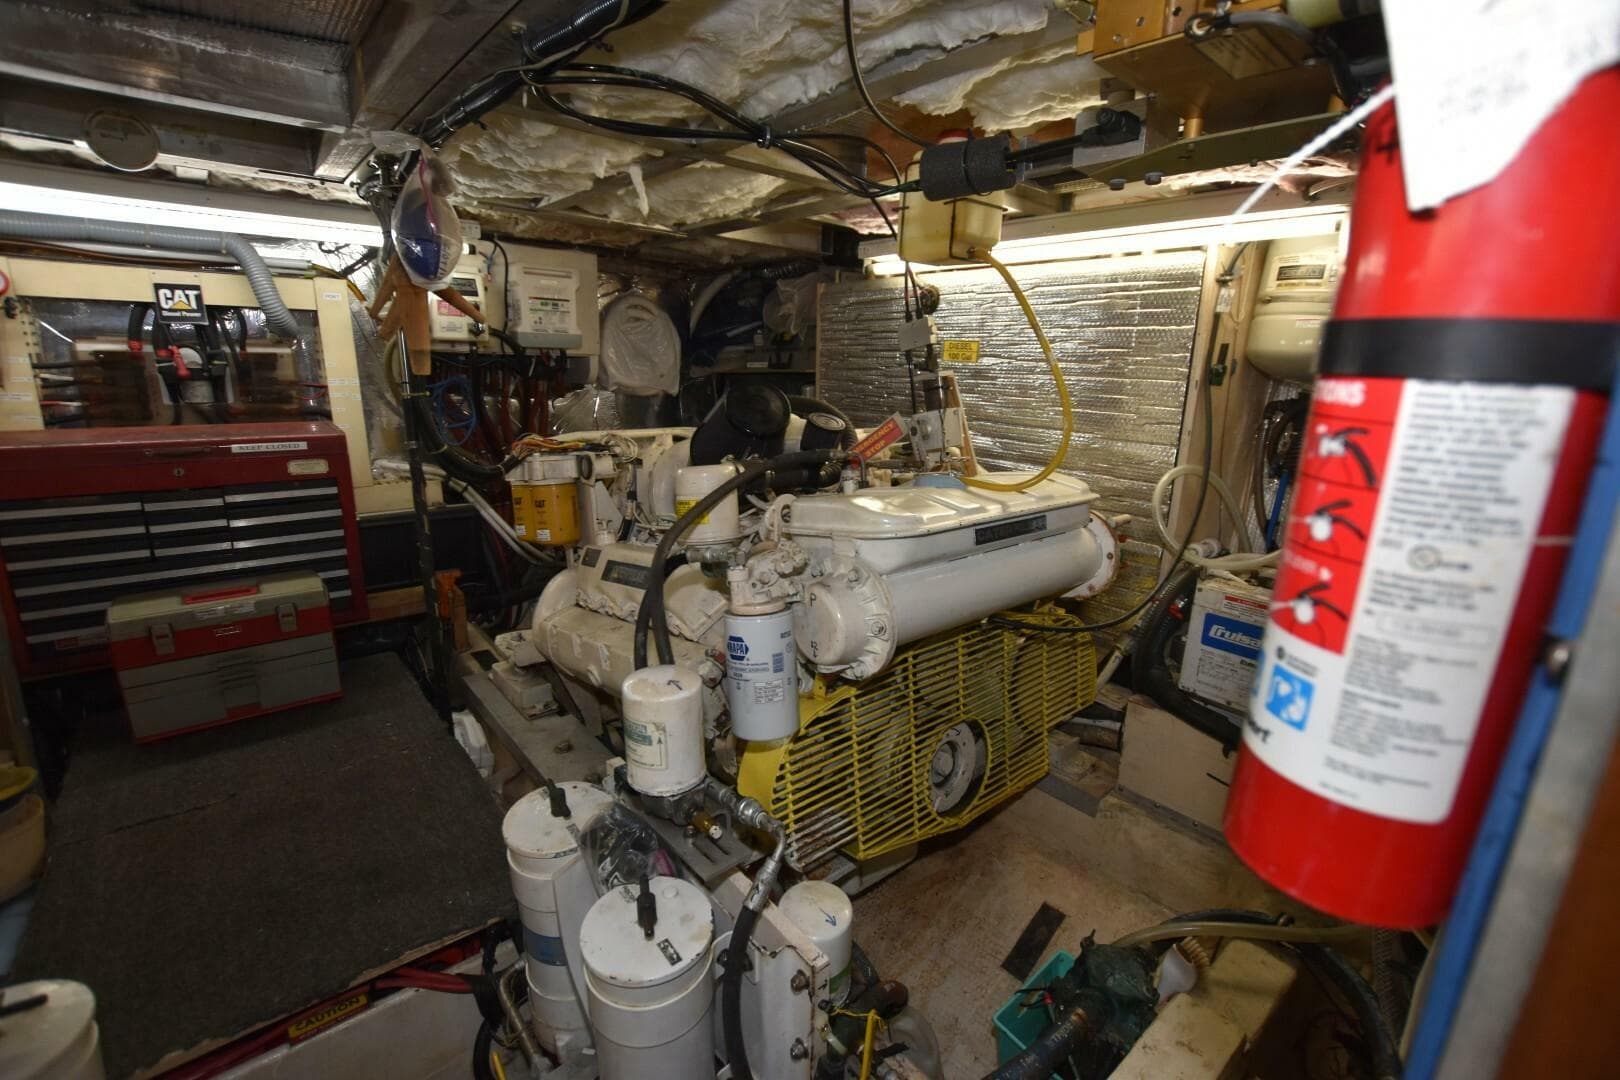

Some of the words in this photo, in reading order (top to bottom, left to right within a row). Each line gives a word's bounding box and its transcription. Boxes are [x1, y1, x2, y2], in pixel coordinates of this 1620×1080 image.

[158, 288, 201, 310] CAT
[948, 342, 973, 351] DIESEL
[948, 352, 960, 360] 100
[961, 353, 973, 361] Gal
[265, 442, 301, 451] CLOSED
[864, 440, 886, 457] STOP
[810, 593, 817, 607] P
[728, 641, 746, 655] NAPA
[295, 997, 361, 1031] CAUTION
